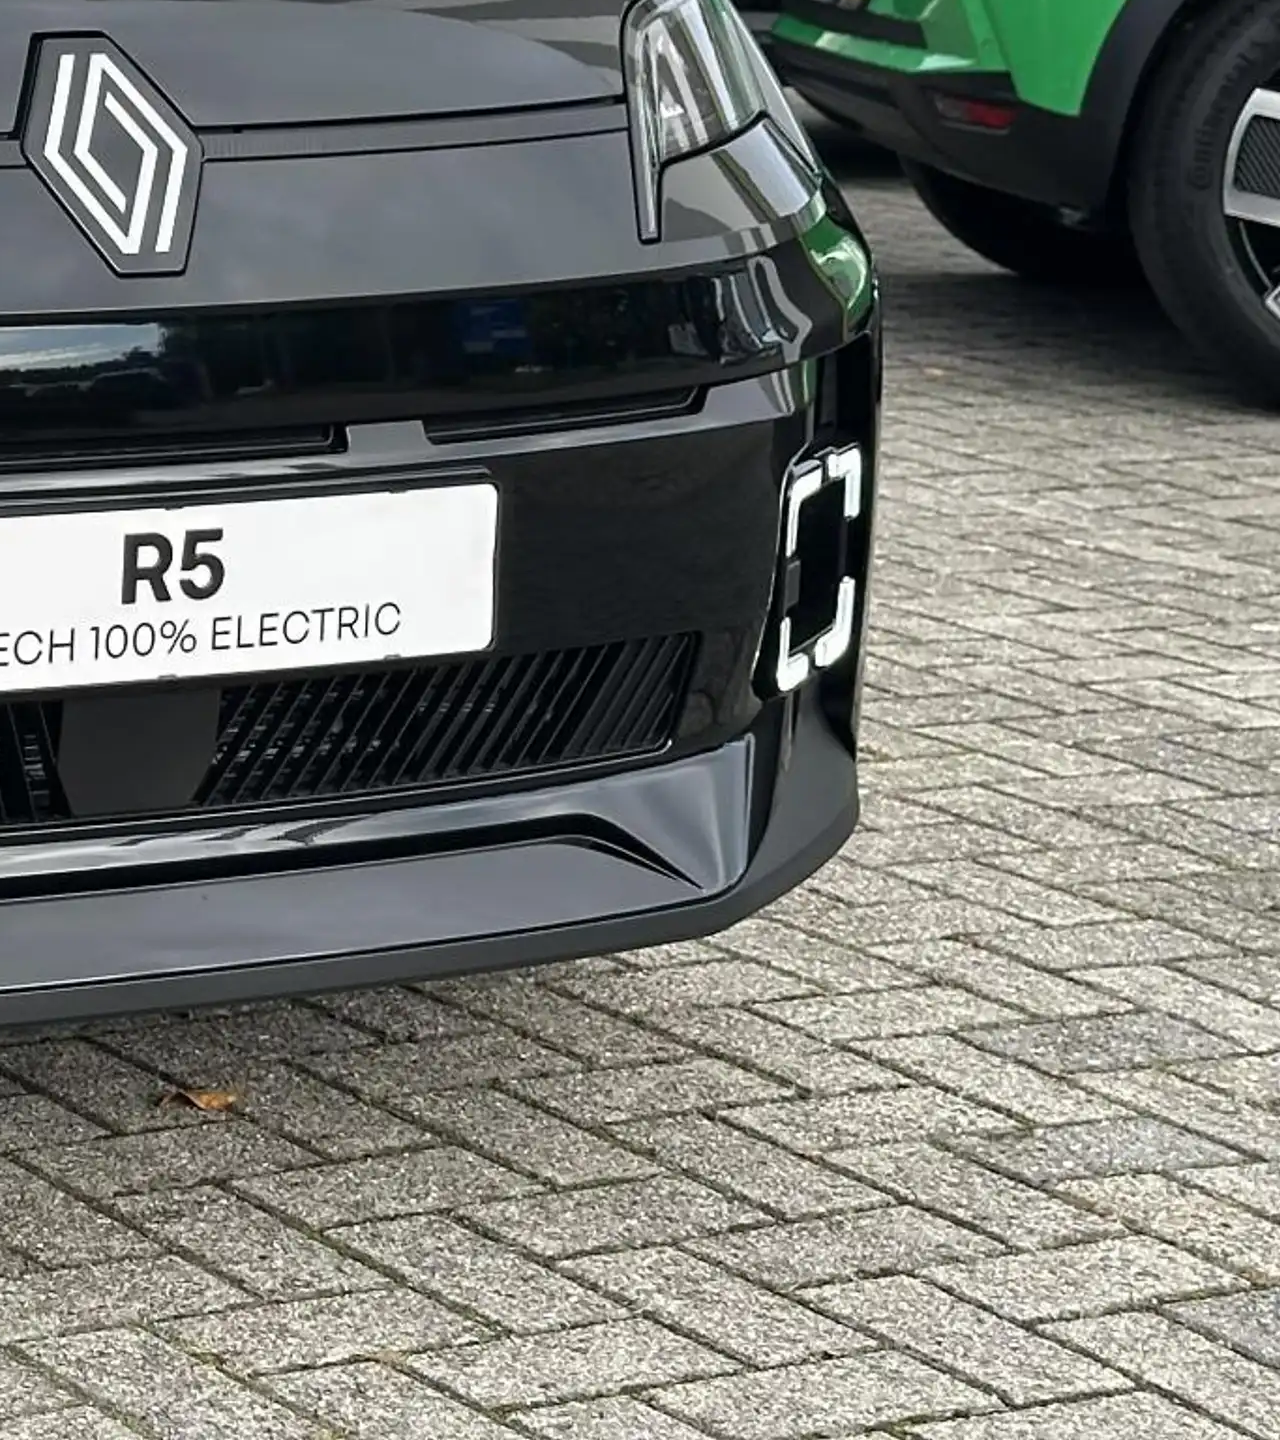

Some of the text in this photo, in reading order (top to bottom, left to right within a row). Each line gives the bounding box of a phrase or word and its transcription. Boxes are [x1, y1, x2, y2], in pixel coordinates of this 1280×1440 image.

[121, 528, 226, 605] R5
[90, 618, 198, 661] 100%
[211, 601, 403, 652] ELECTRIC
